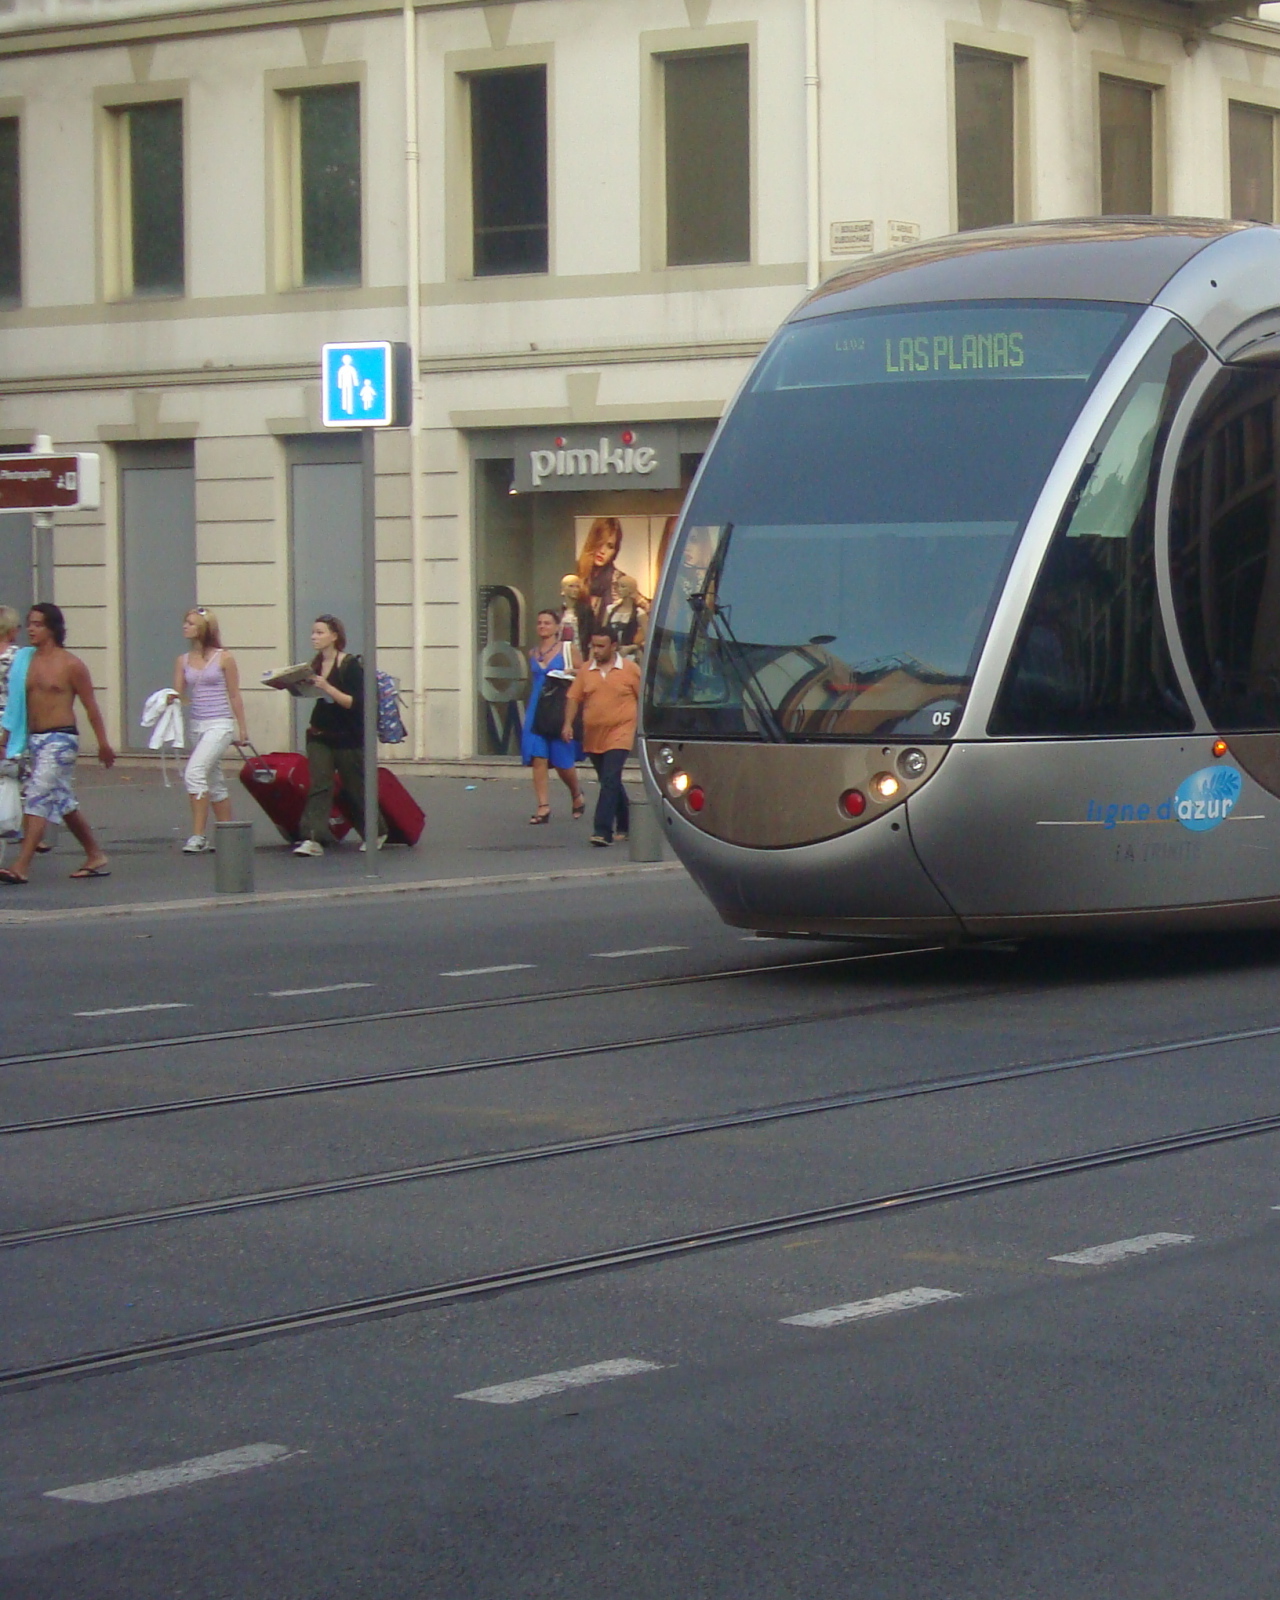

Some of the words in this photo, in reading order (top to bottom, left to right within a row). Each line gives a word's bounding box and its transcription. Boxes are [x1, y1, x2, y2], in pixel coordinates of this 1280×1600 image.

[886, 337, 930, 372] LAS
[933, 332, 1024, 370] PLANAS
[530, 430, 658, 486] pimkie
[932, 711, 951, 726] 05
[1086, 799, 1150, 829] ligne
